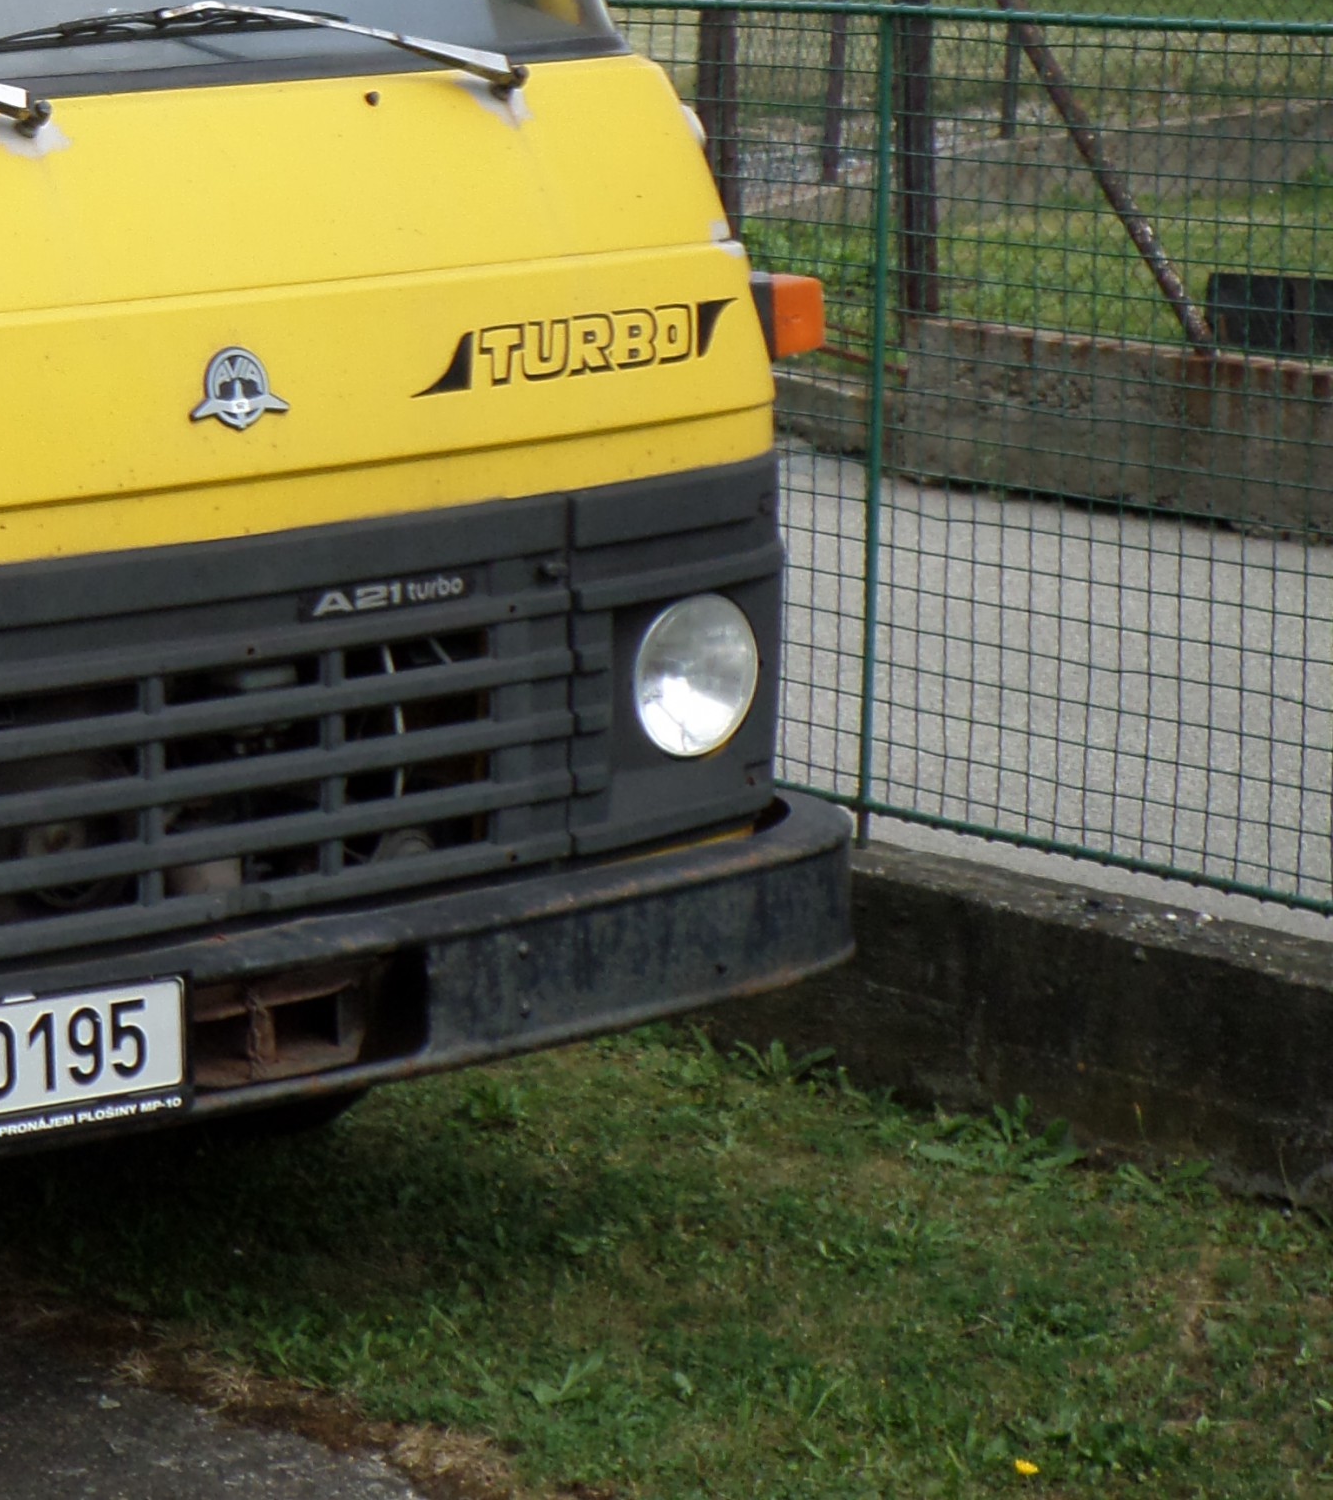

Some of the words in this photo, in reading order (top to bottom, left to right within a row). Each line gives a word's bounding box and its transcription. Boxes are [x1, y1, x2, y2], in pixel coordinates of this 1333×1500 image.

[480, 302, 693, 387] TURBO
[312, 581, 402, 617] A21
[407, 574, 464, 601] turbo
[77, 1104, 137, 1123] PLOŠINY
[140, 1097, 182, 1113] MP-10
